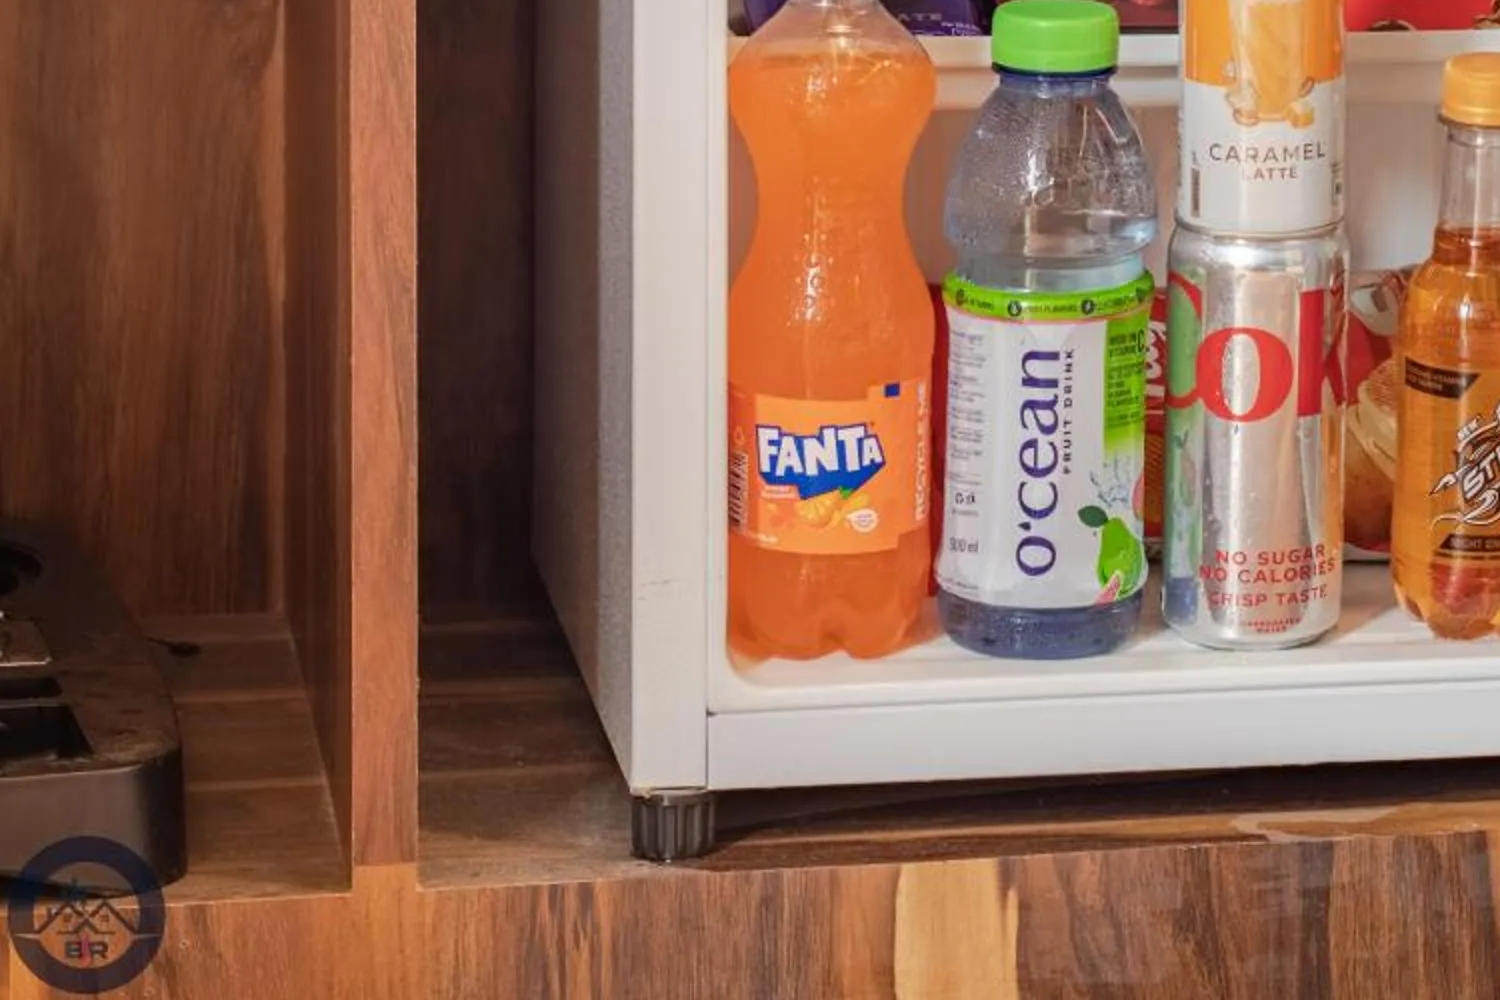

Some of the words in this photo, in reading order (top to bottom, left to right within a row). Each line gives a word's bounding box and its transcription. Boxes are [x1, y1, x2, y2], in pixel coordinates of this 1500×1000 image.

[1209, 141, 1325, 163] CARAMEL
[1062, 349, 1074, 409] DRINK
[756, 424, 884, 477] FANTA
[1062, 419, 1074, 476] FRUIT
[1216, 550, 1247, 565] NO
[1258, 544, 1325, 566] SUGAR
[1200, 565, 1227, 582] NO
[1238, 557, 1336, 584] CALORIES
[1209, 590, 1267, 607] CRISP
[1275, 584, 1328, 606] TASTE
